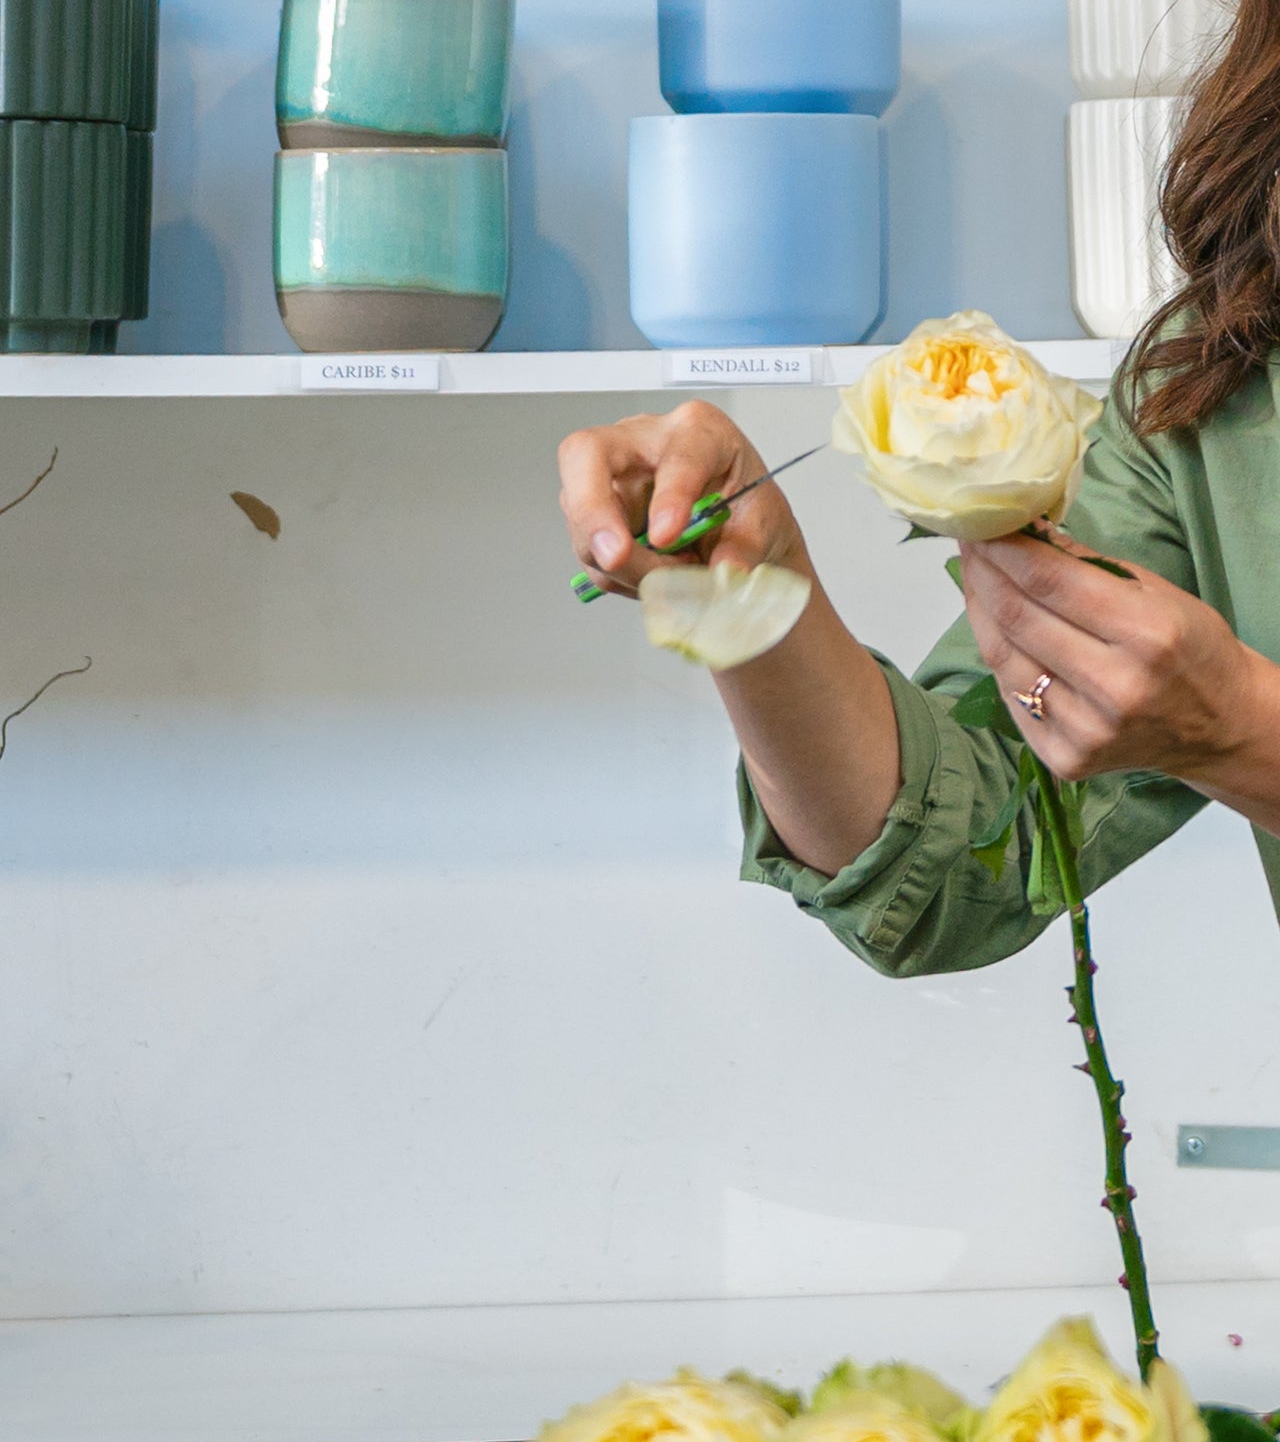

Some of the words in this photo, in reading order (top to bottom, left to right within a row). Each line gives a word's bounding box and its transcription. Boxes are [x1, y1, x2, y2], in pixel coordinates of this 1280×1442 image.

[322, 365, 386, 378] CARIBE
[391, 365, 415, 379] $11
[690, 359, 770, 372] KENDALL
[774, 359, 800, 373] $12
